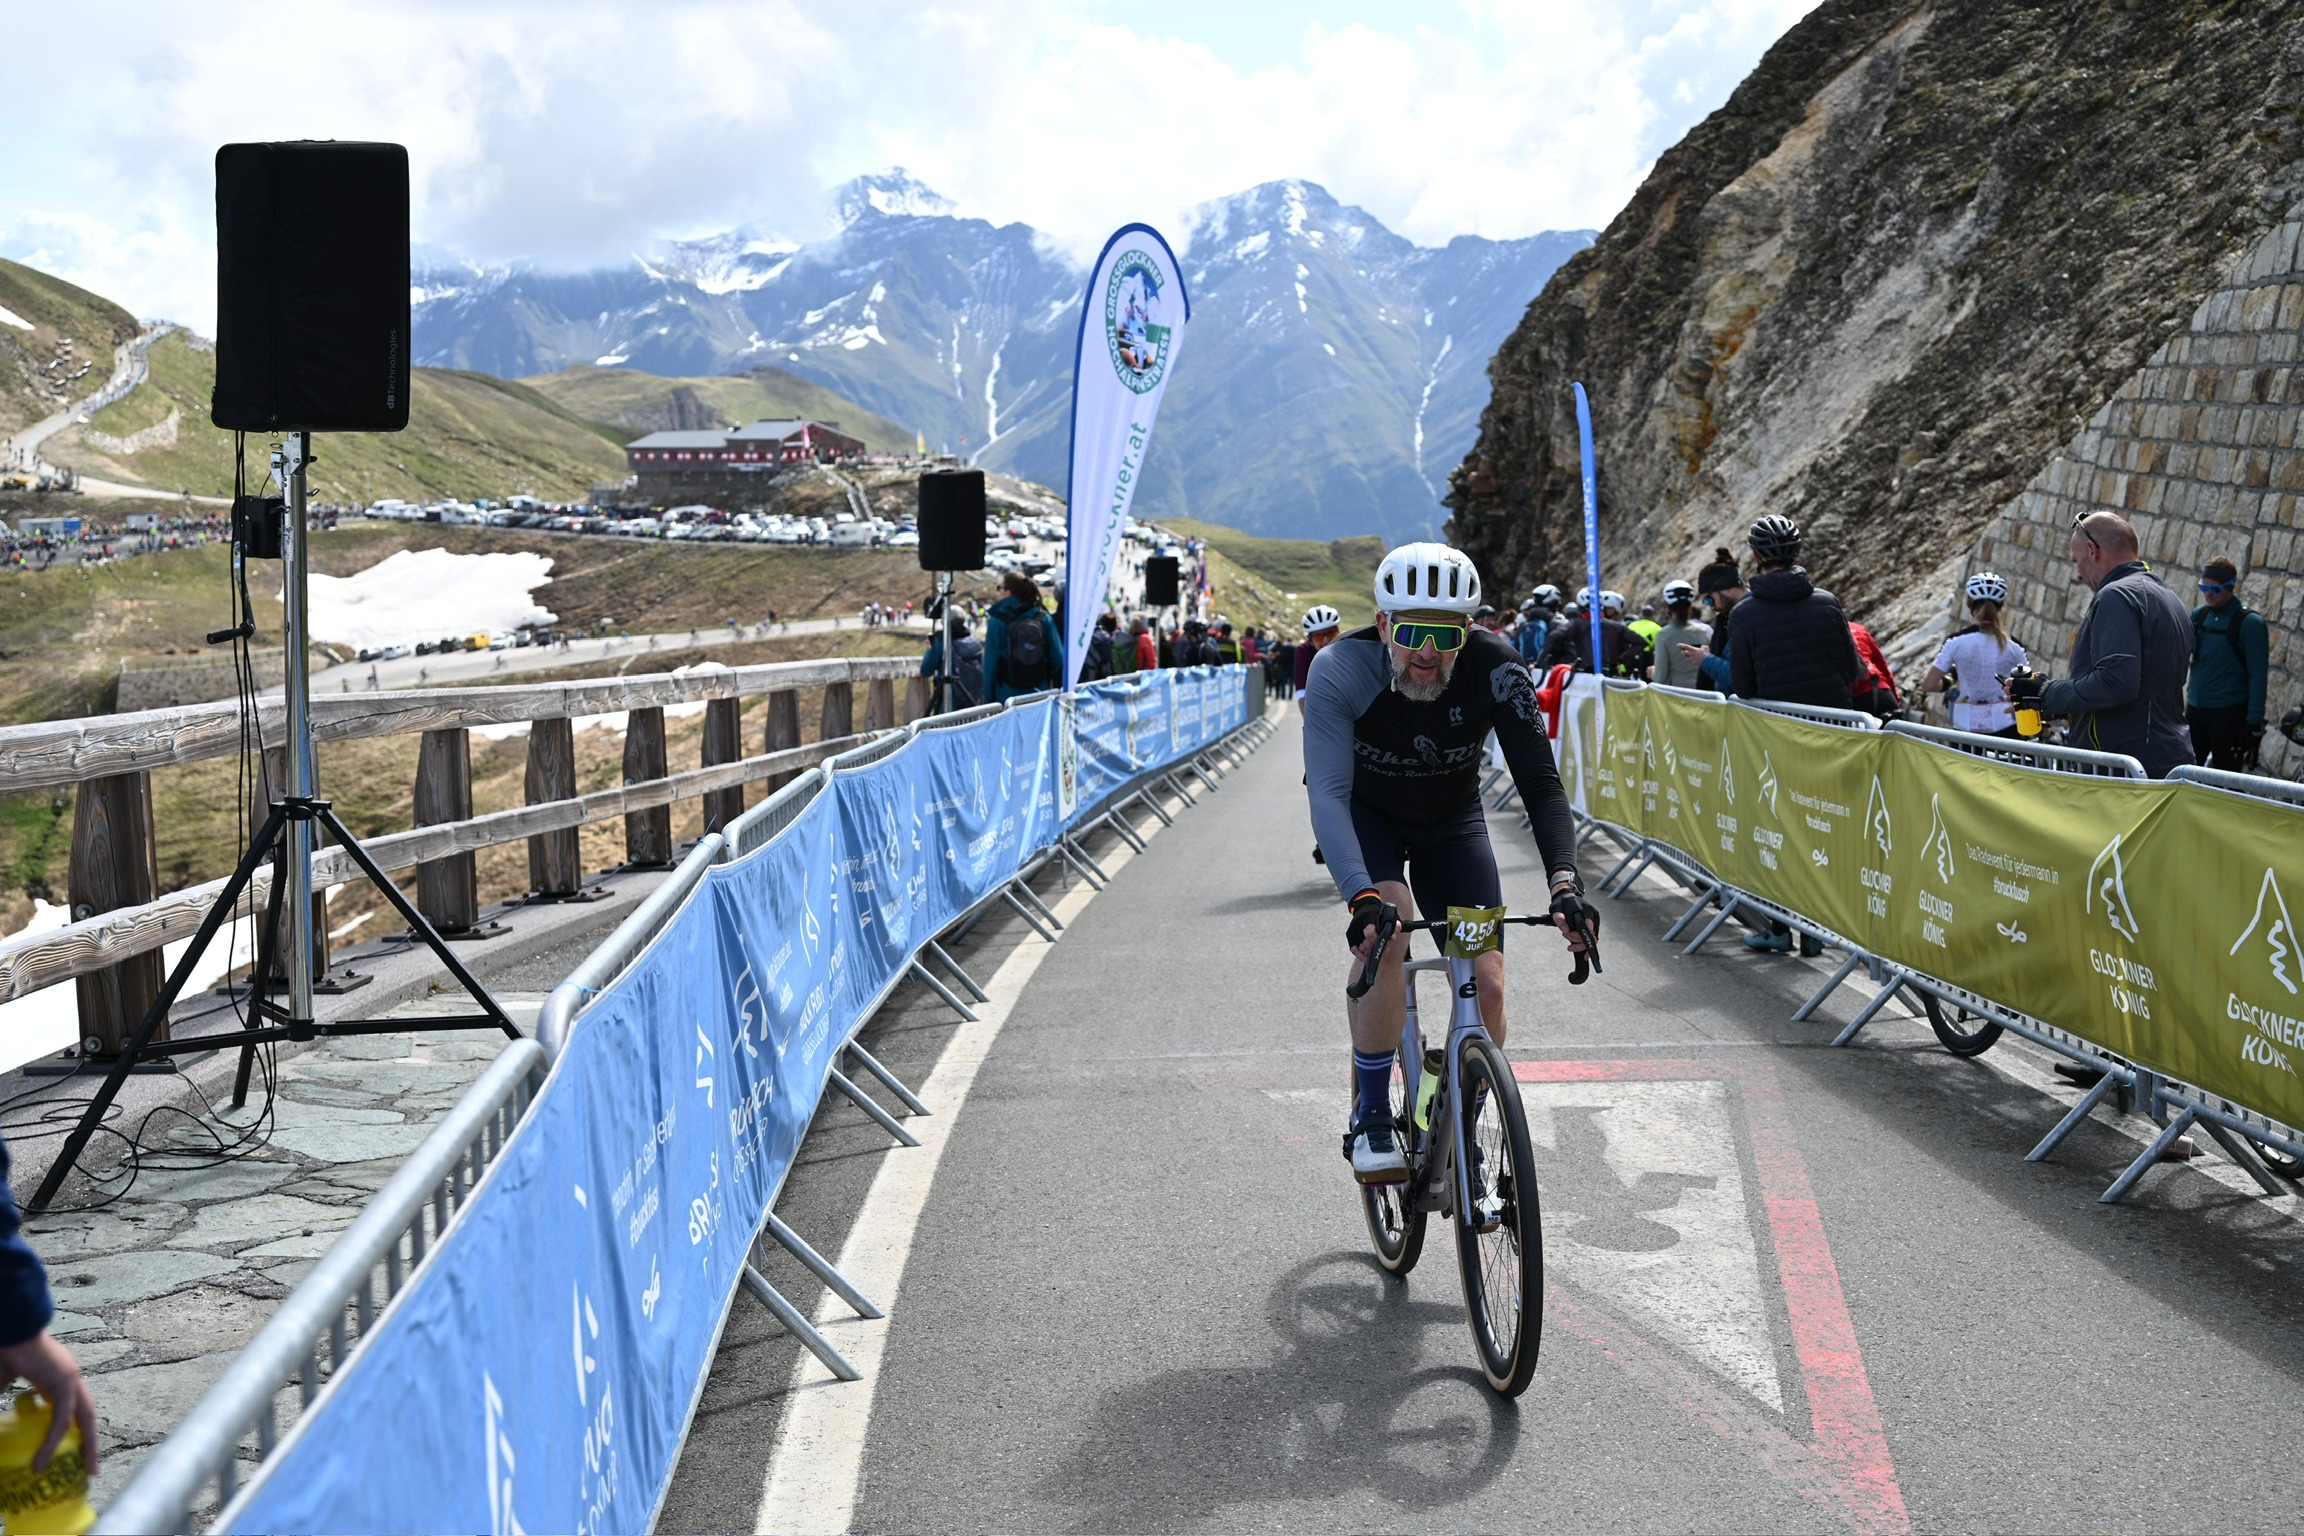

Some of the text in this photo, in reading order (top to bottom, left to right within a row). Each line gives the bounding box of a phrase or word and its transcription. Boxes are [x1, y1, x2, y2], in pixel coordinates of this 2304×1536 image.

[1107, 250, 1163, 320] GROSSGLOCKNER
[387, 330, 398, 409] dBTechnologies
[1107, 325, 1169, 391] HOCHALPNSTRASSE
[1354, 738, 1422, 766] Bike
[1977, 846, 2004, 870] Radevent
[2003, 853, 2013, 873] für
[2013, 857, 2051, 882] jedermann
[2051, 866, 2059, 885] in
[1919, 889, 1953, 923] GLOCKNER
[1993, 876, 2030, 903] #bruckfusch
[1455, 919, 1495, 942] 4258
[1923, 917, 1946, 948] KÖNIG
[2110, 984, 2151, 1020] KÖNIG
[2227, 992, 2304, 1051] GLOCKNER
